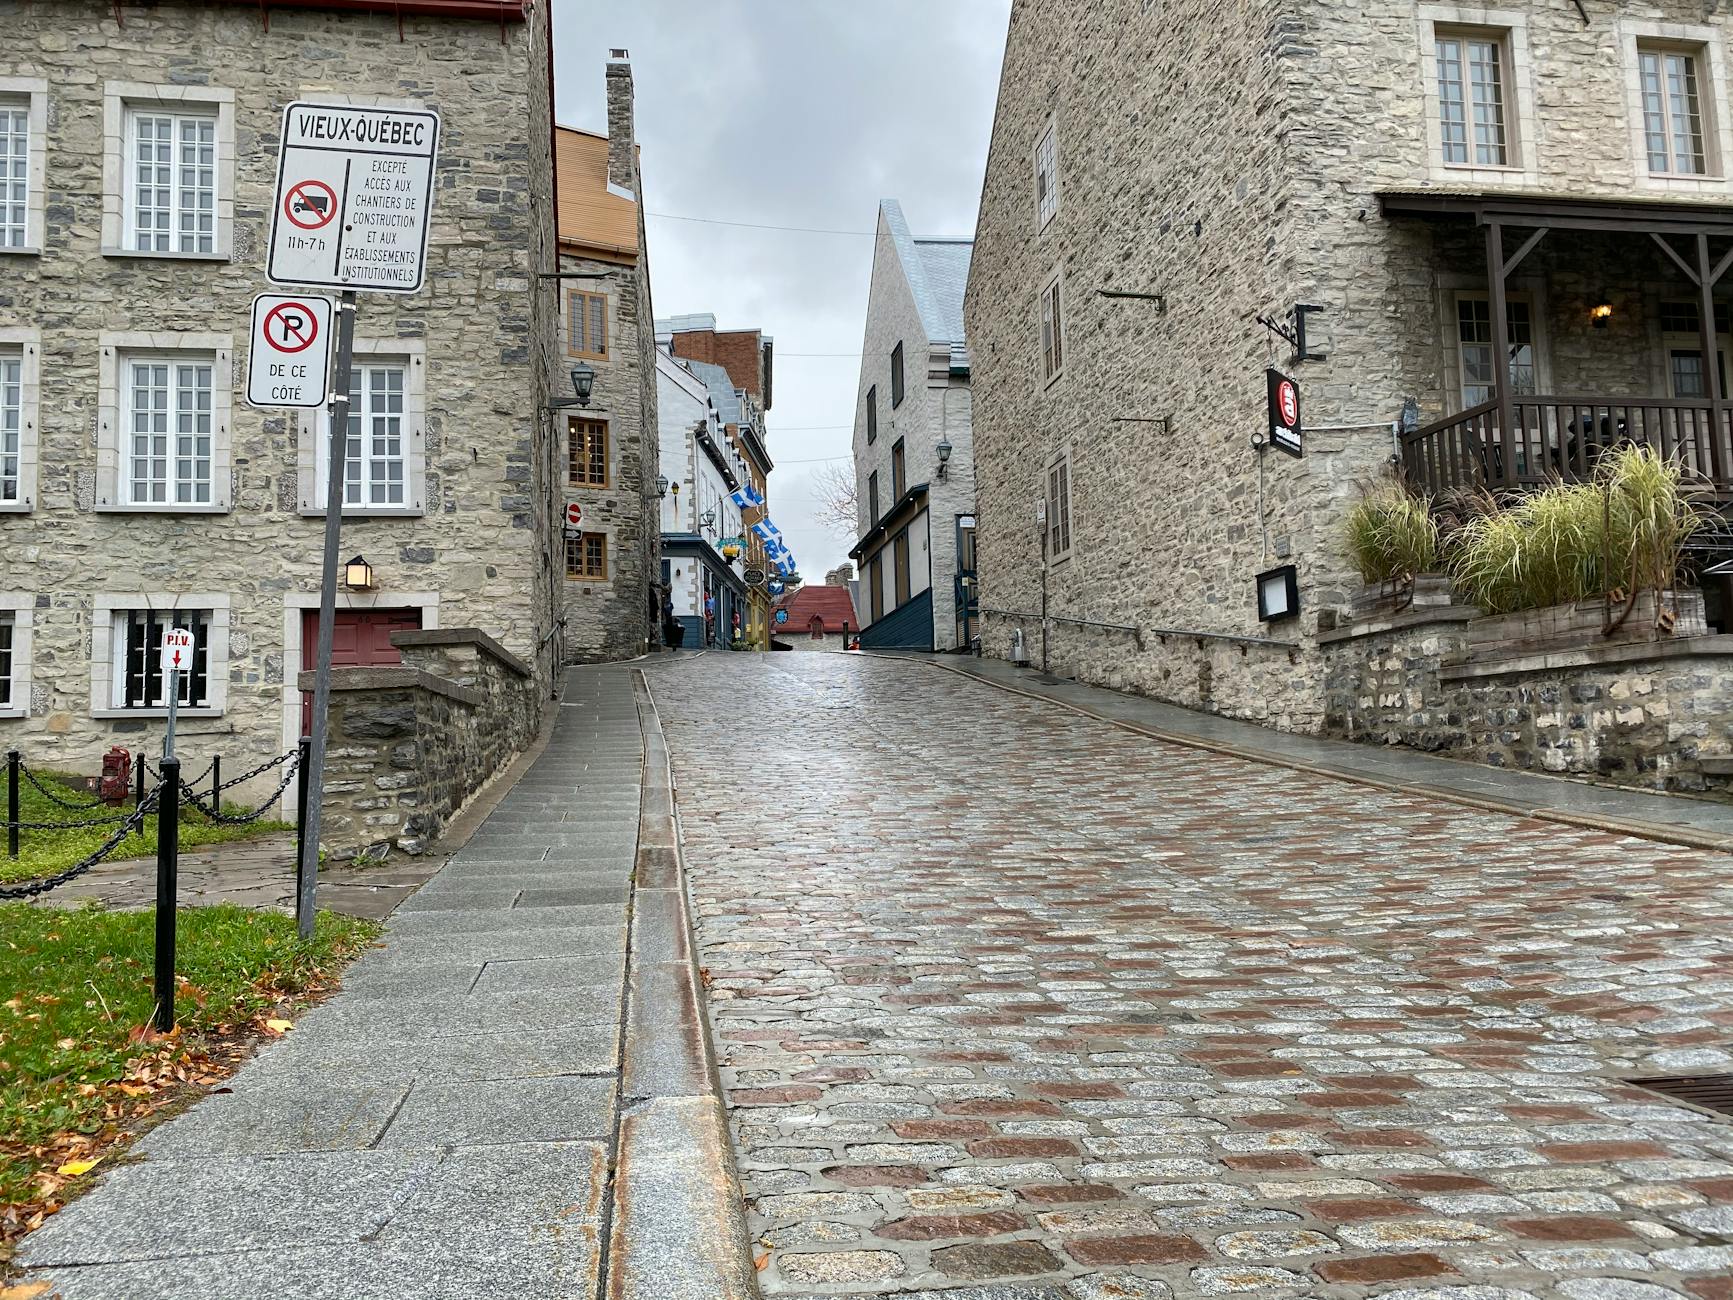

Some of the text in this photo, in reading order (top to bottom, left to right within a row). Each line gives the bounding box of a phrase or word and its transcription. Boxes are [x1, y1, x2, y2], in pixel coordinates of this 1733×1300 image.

[299, 114, 425, 146] VIEUX-QUÉBEC
[372, 159, 408, 174] EXCEPTÉ
[364, 175, 412, 192] ACCÈS AUX
[355, 194, 417, 210] CHANTIERS DE
[353, 212, 416, 228] CONSTRUCTION
[367, 230, 397, 245] ET AUX
[344, 245, 415, 263] ÉTABLISSEMENTS
[342, 265, 414, 281] INSTITUTIONNELS
[269, 364, 307, 378] DE CE
[271, 384, 302, 400] CÔTÉ
[166, 634, 190, 647] P.I.V.
